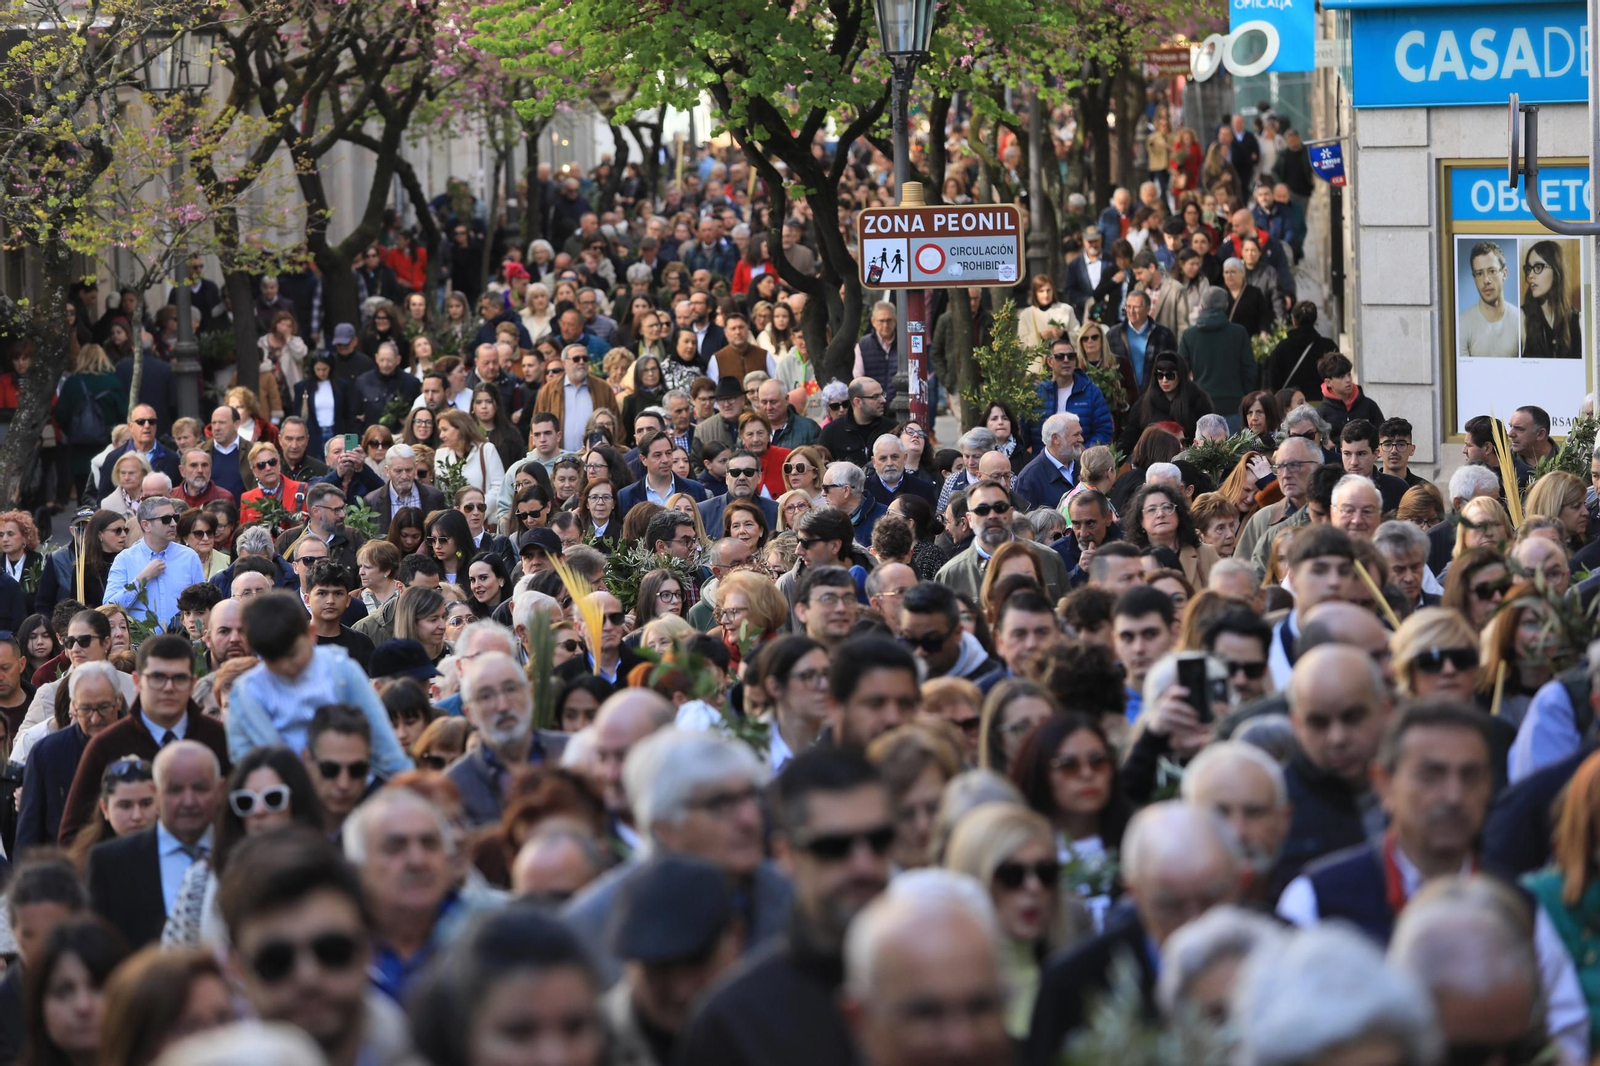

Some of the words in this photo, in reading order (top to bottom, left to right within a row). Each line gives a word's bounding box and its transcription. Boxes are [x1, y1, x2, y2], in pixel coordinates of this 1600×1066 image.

[864, 214, 925, 234] ZONA
[933, 211, 1016, 232] PEONIL
[950, 243, 1014, 256] CIRCULACIÓN
